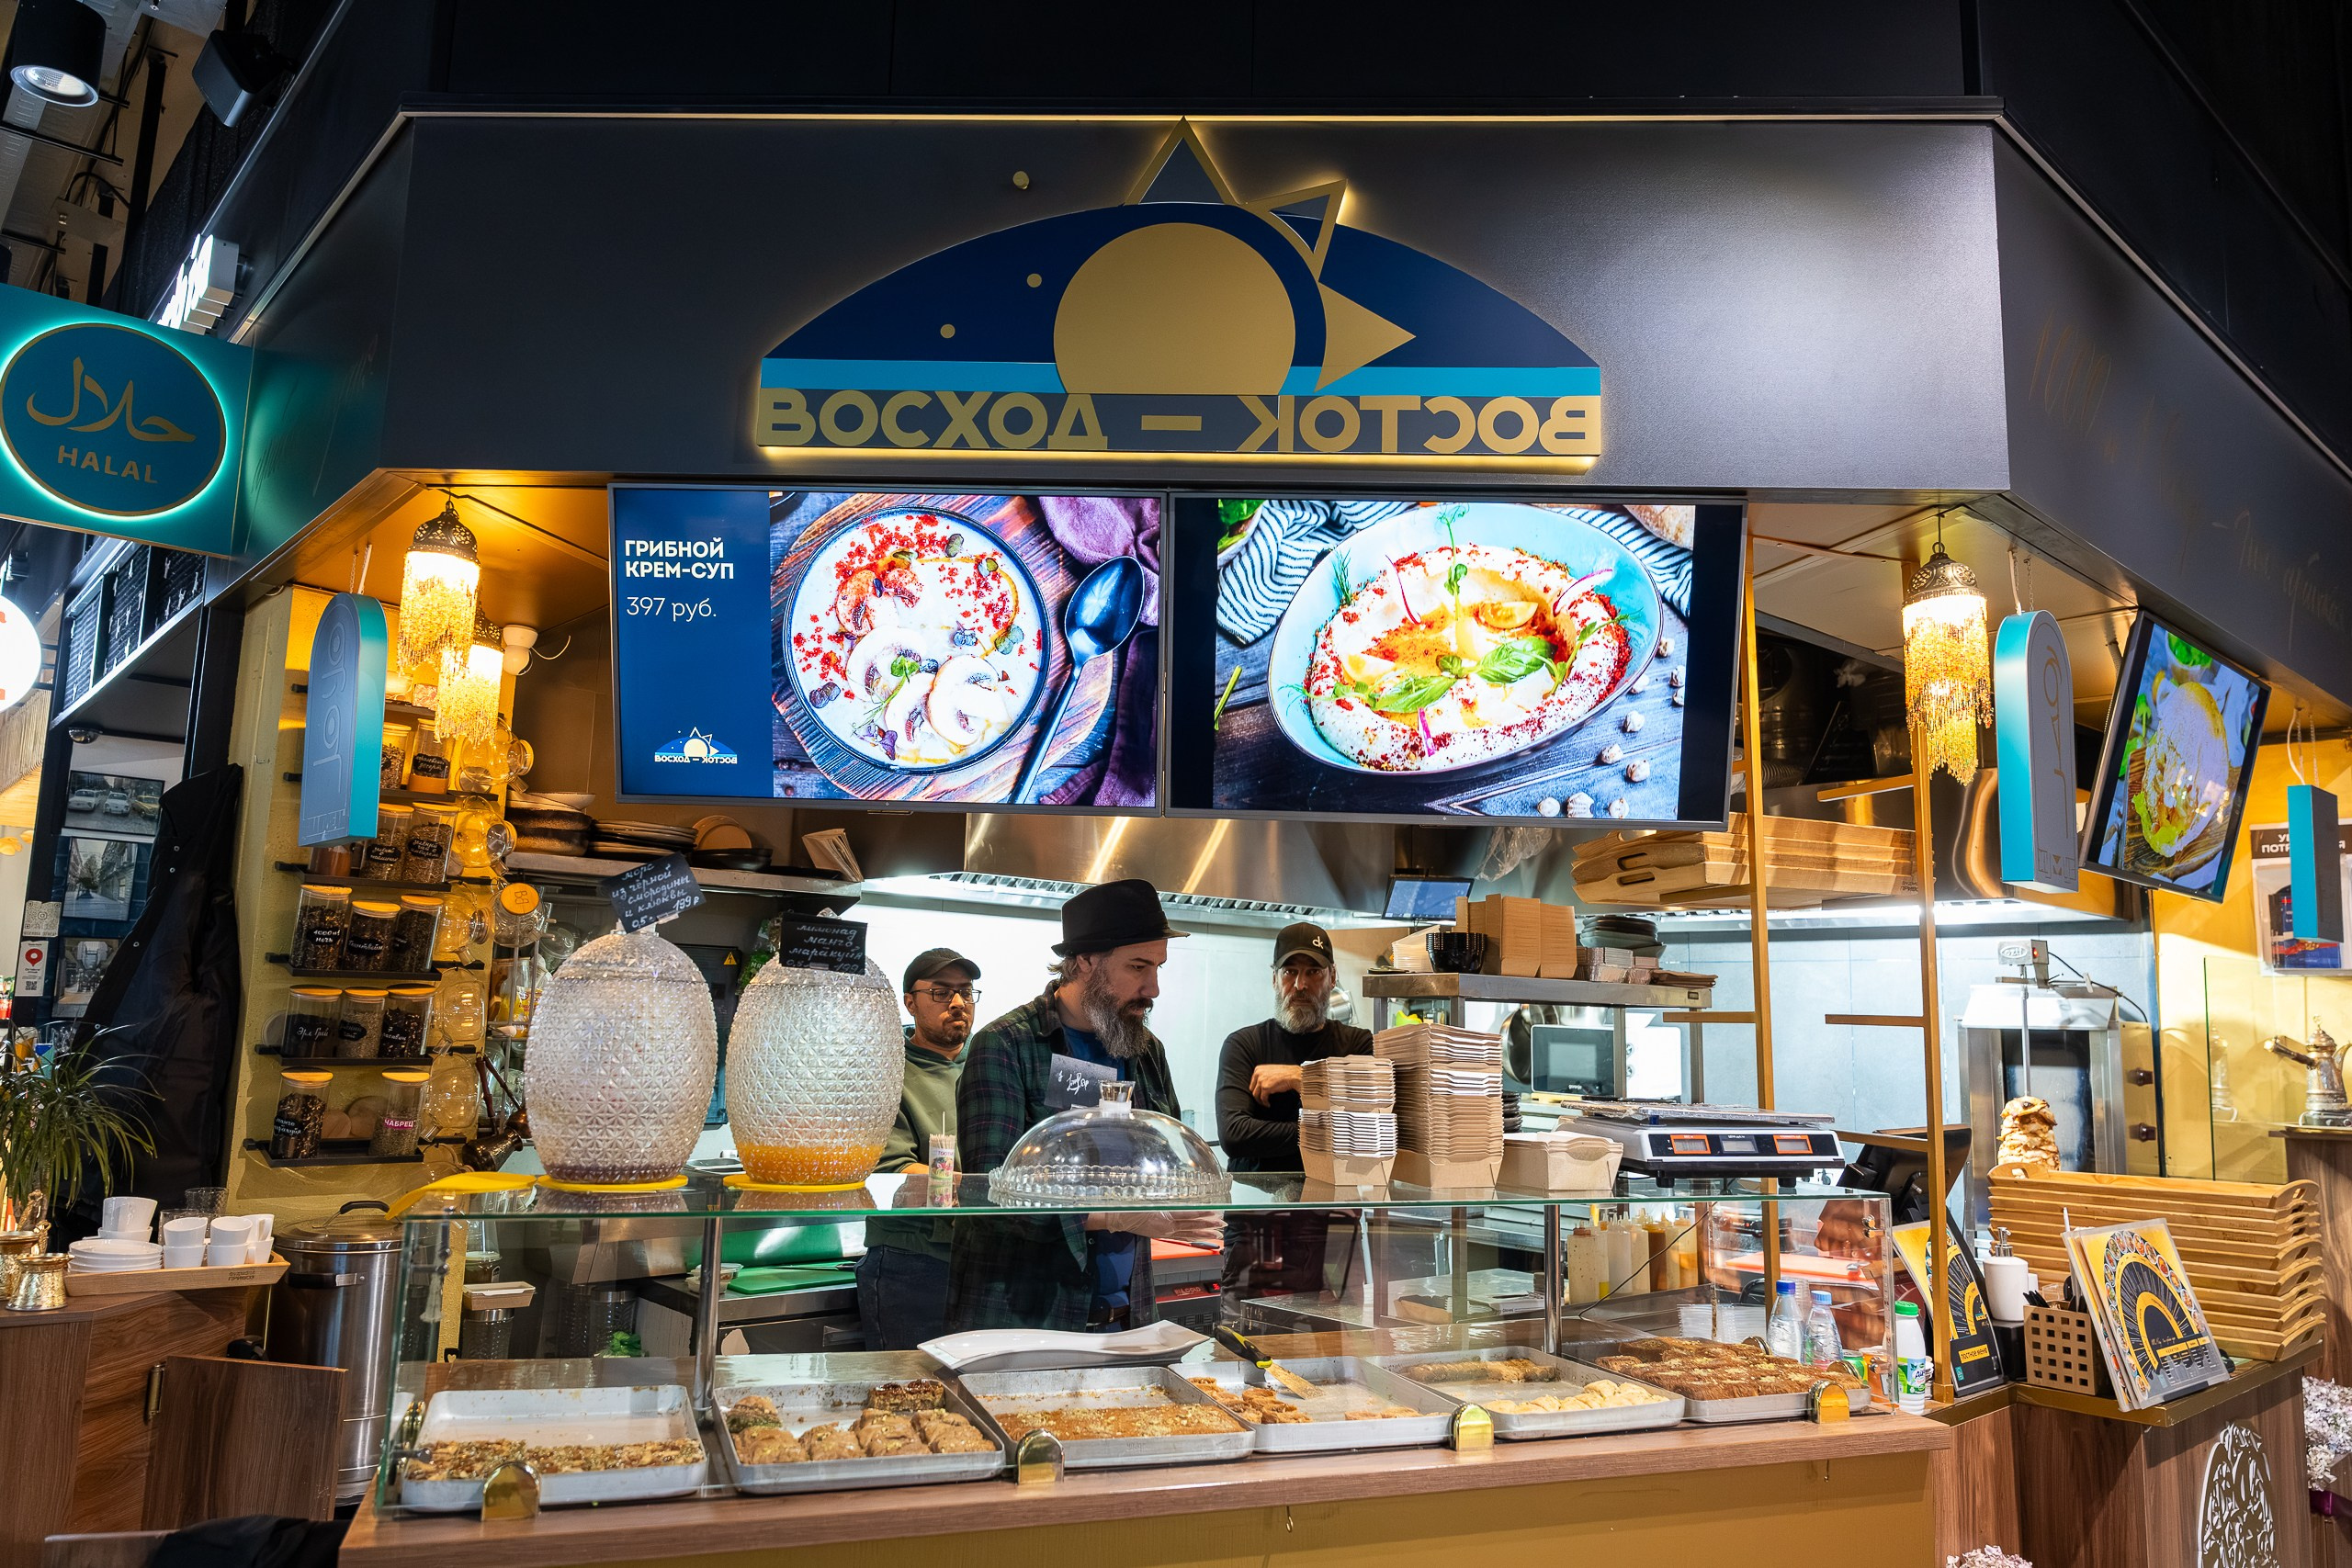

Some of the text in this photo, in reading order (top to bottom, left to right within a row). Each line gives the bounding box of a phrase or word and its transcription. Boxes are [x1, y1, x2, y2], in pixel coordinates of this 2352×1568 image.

[26, 355, 197, 443] حلال
[757, 388, 1108, 449] ВОСХОД
[58, 445, 158, 483] HALAL
[625, 536, 724, 558] ГРИБНОЙ
[625, 560, 734, 580] КРЕМ-СУП
[627, 596, 717, 622] 397 руб.
[612, 863, 672, 899] из чёрной
[621, 863, 655, 880] морс
[628, 875, 691, 905] смородины
[625, 889, 687, 918] и клюквы
[797, 924, 858, 941] лимонад
[804, 936, 853, 947] манго
[788, 946, 864, 962] маракуйя
[384, 1119, 413, 1127] ЧАБРЕЦ
